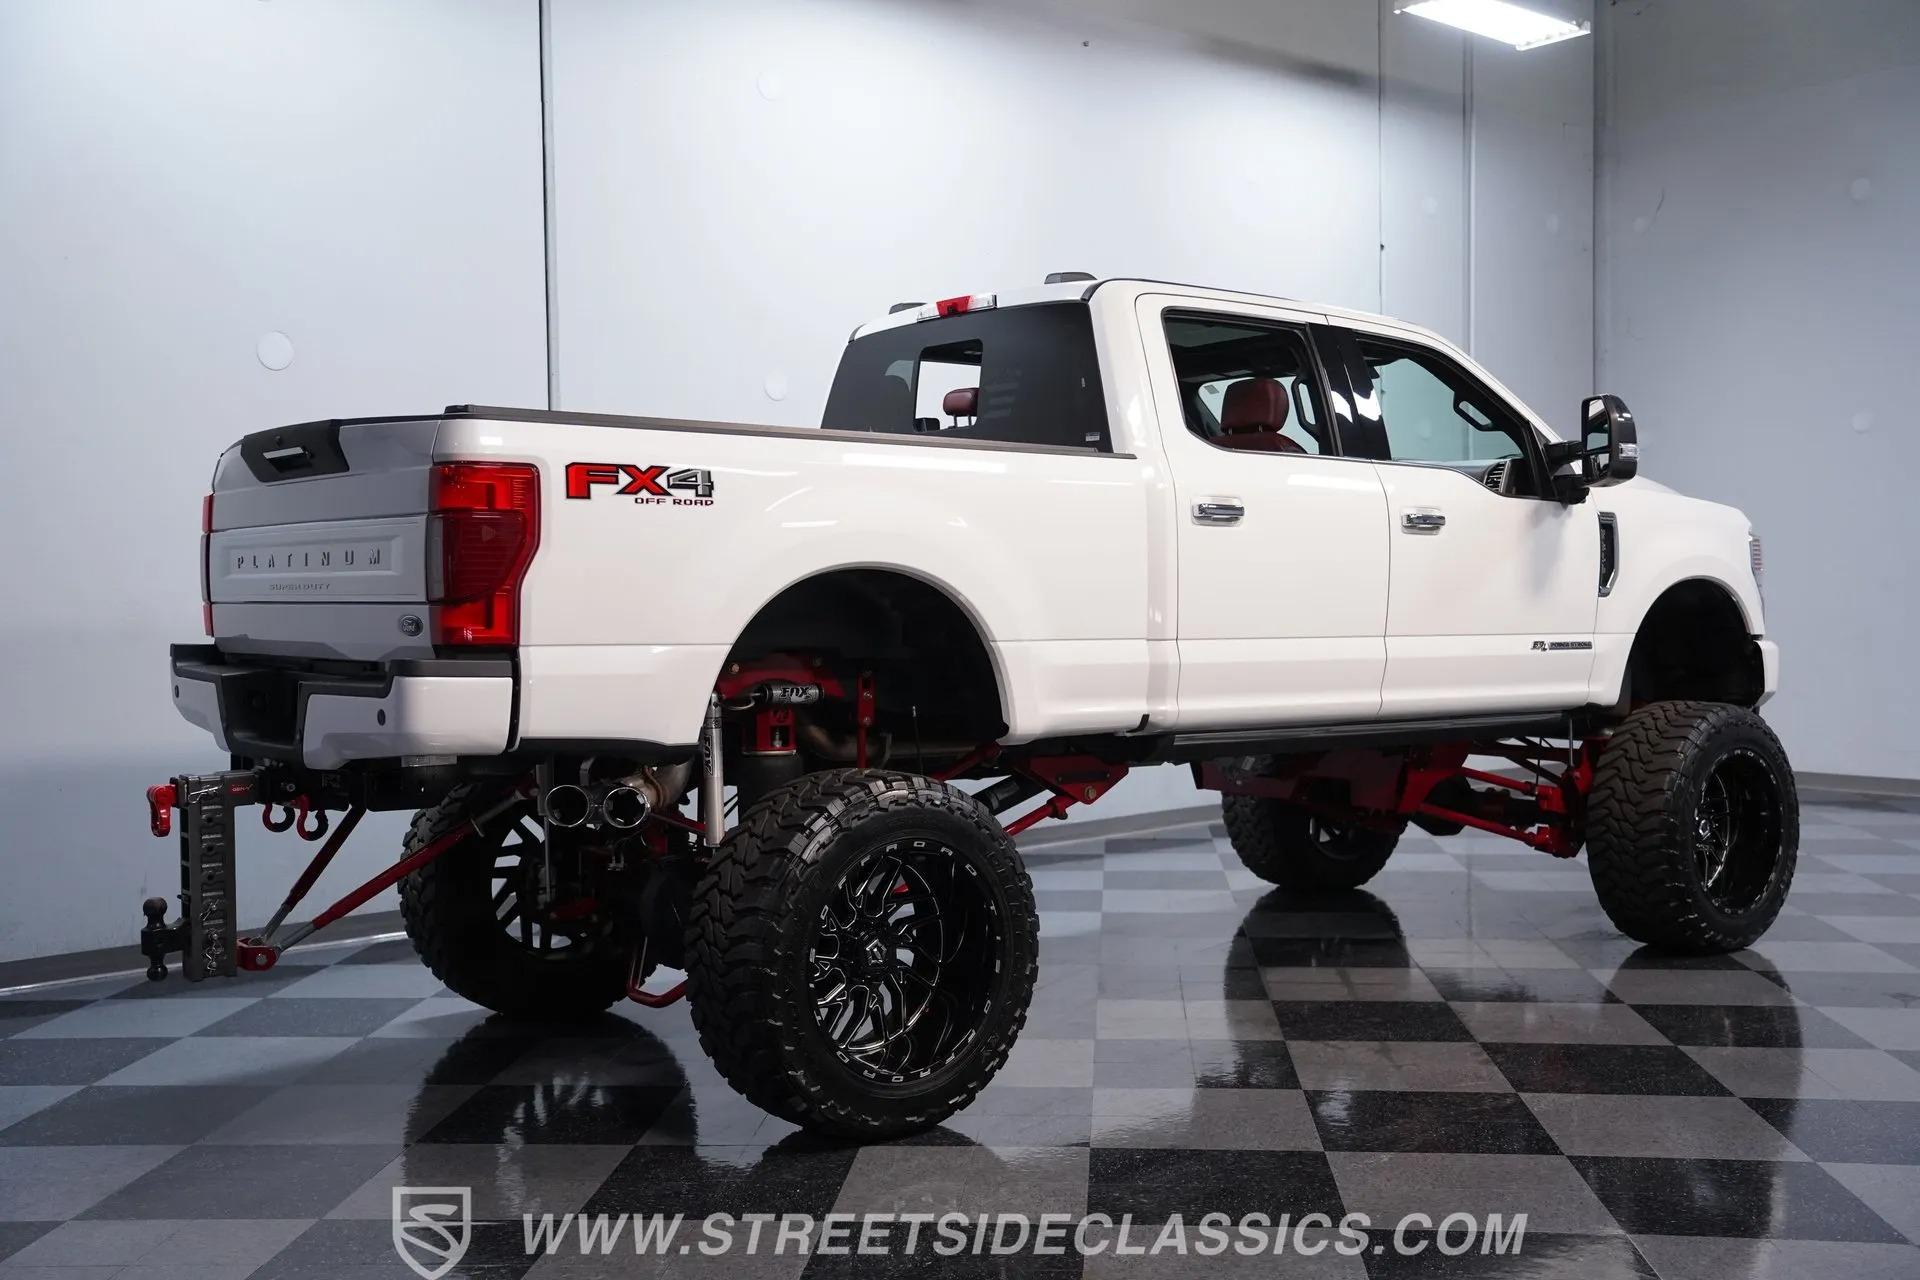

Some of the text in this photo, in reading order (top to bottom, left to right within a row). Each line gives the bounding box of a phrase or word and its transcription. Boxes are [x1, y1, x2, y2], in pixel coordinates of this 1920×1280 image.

[565, 462, 714, 499] FX4
[634, 497, 714, 506] OFF ROAD
[237, 549, 381, 569] PLATINUM
